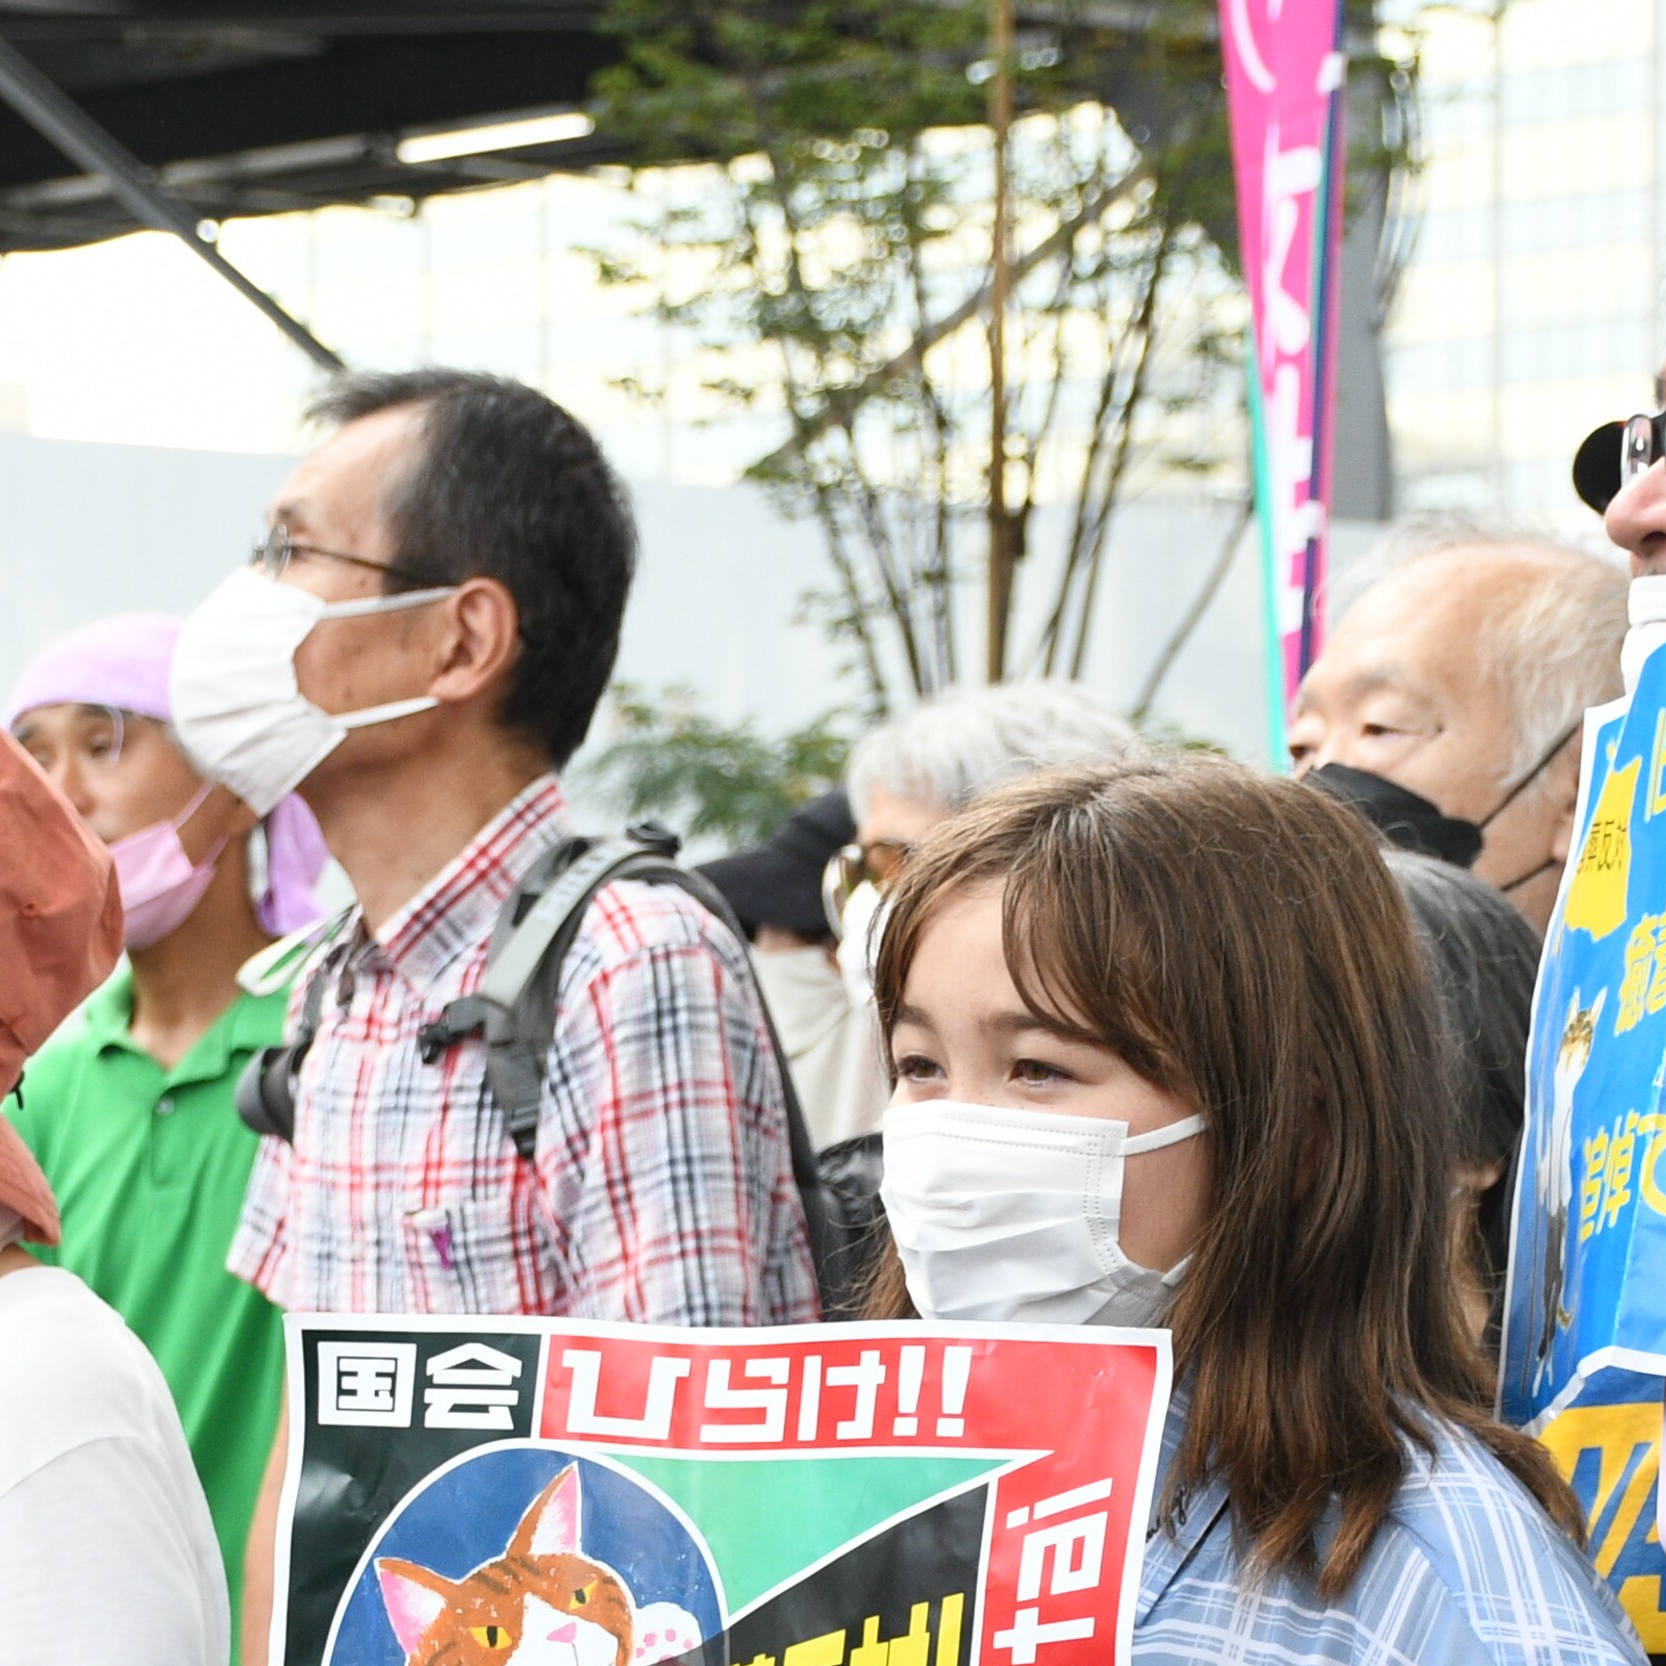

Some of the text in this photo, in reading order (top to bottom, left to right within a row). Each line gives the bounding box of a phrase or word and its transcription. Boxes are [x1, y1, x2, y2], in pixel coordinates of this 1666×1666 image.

[317, 1340, 973, 1445] 国会 ひらけ!!
